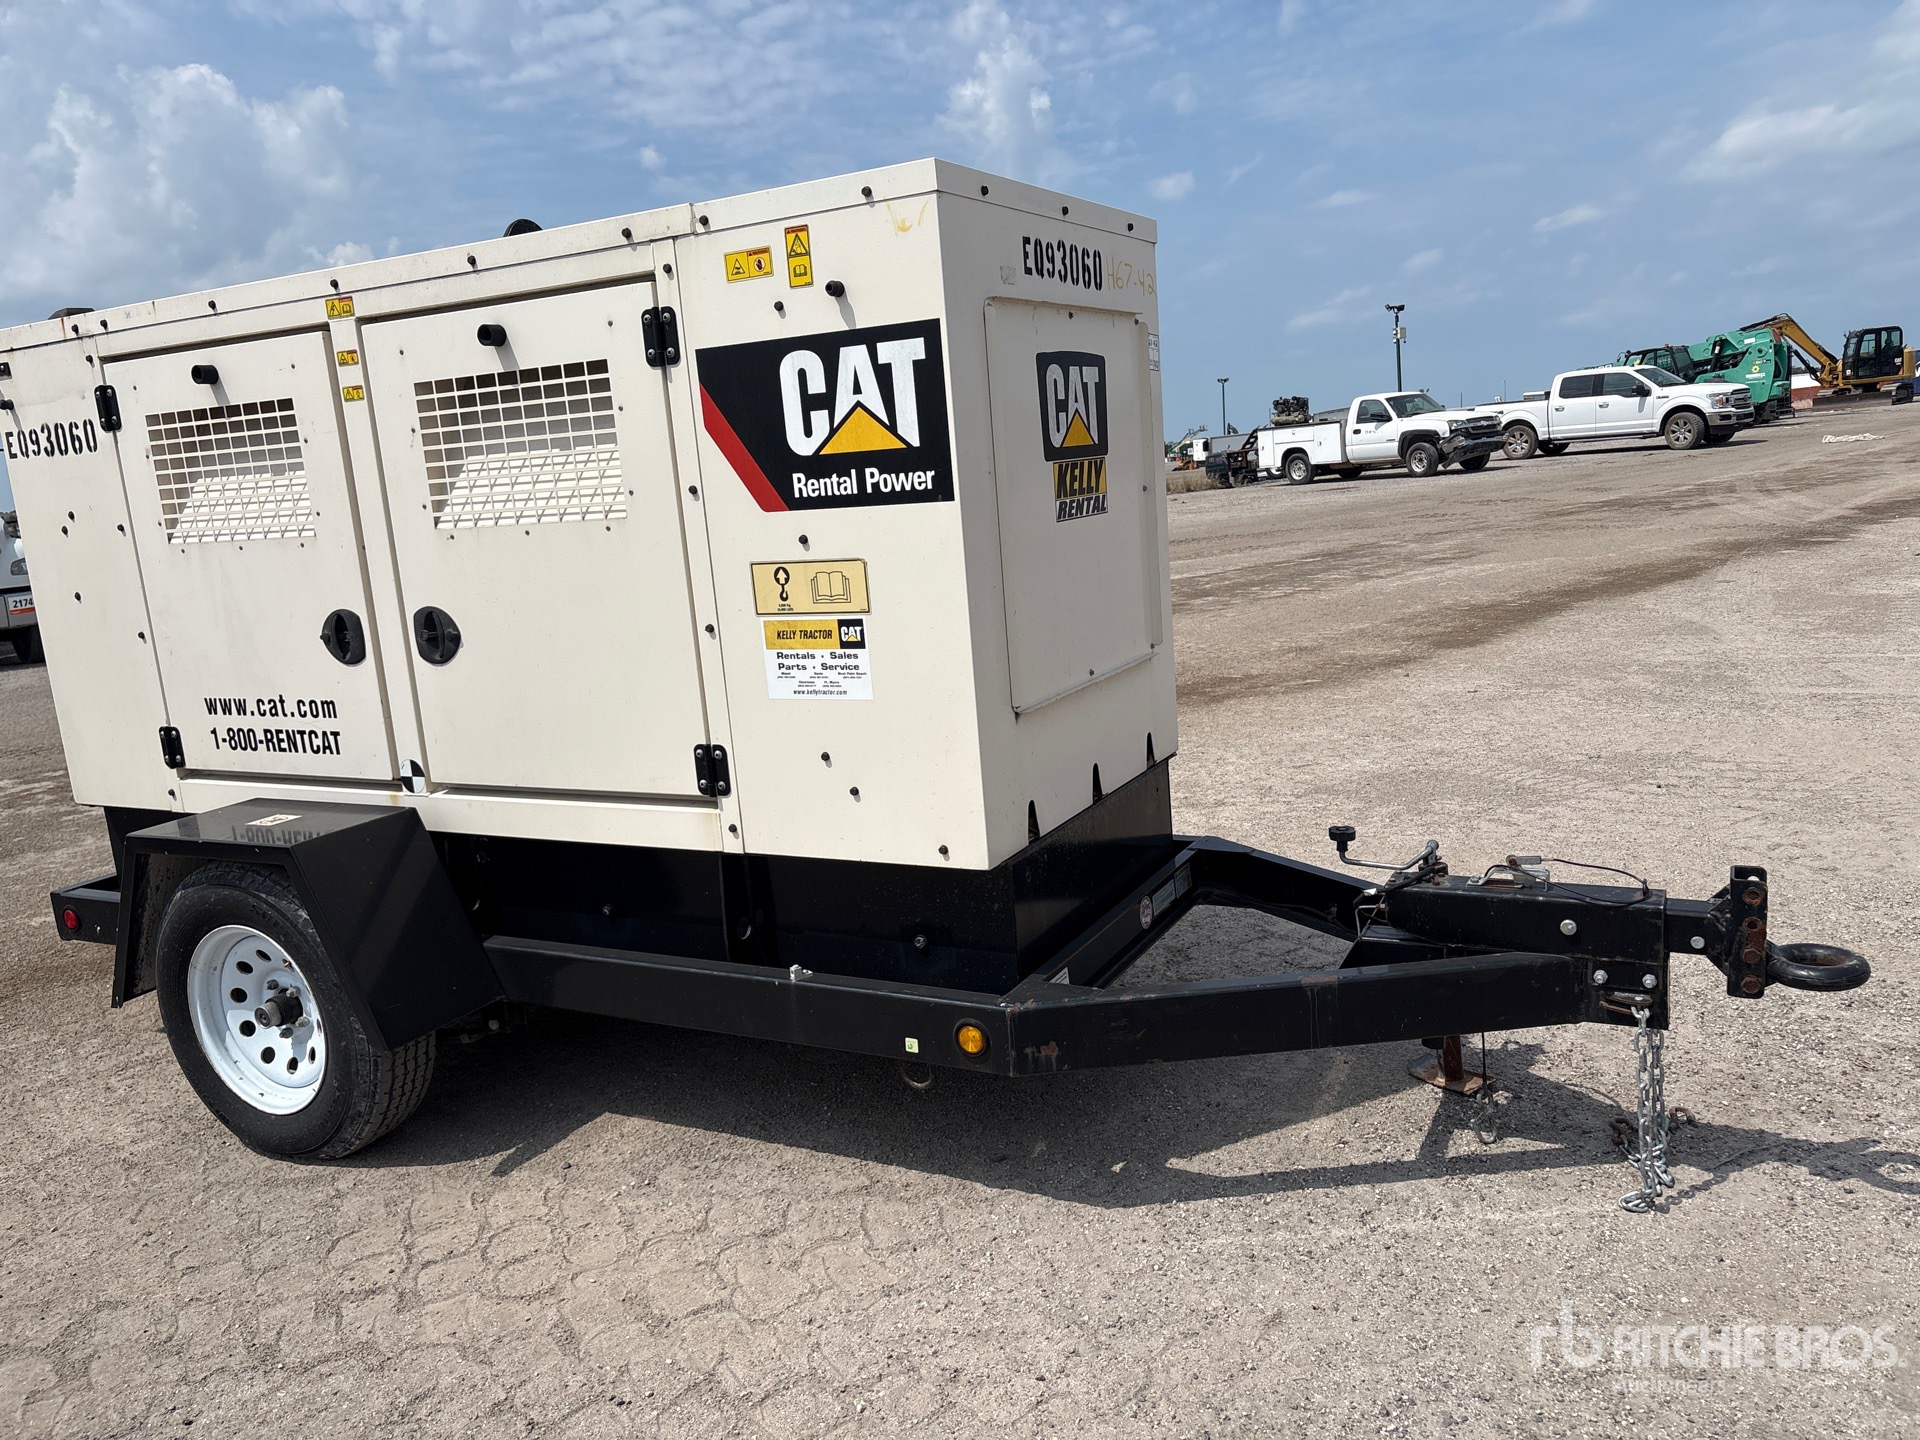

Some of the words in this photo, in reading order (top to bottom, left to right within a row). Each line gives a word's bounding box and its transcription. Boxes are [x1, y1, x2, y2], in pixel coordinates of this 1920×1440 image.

[1022, 236, 1103, 291] EQ93060
[779, 337, 926, 456] CAT
[1046, 363, 1100, 448] CAT
[5, 418, 98, 460] EQ93060
[792, 469, 858, 498] Rental
[864, 467, 936, 494] Power
[1056, 459, 1105, 500] KELLY
[1057, 493, 1107, 520] RENTAL
[776, 629, 798, 640] KELLY
[799, 629, 833, 640] TRACTOR
[840, 626, 863, 642] CAT
[776, 651, 816, 660] Rentals
[829, 651, 859, 660] Sales
[777, 662, 807, 671] Parts
[820, 662, 860, 671] Service
[204, 694, 338, 719] www.cat.com
[210, 727, 341, 755] 1-800-RENTCAT
